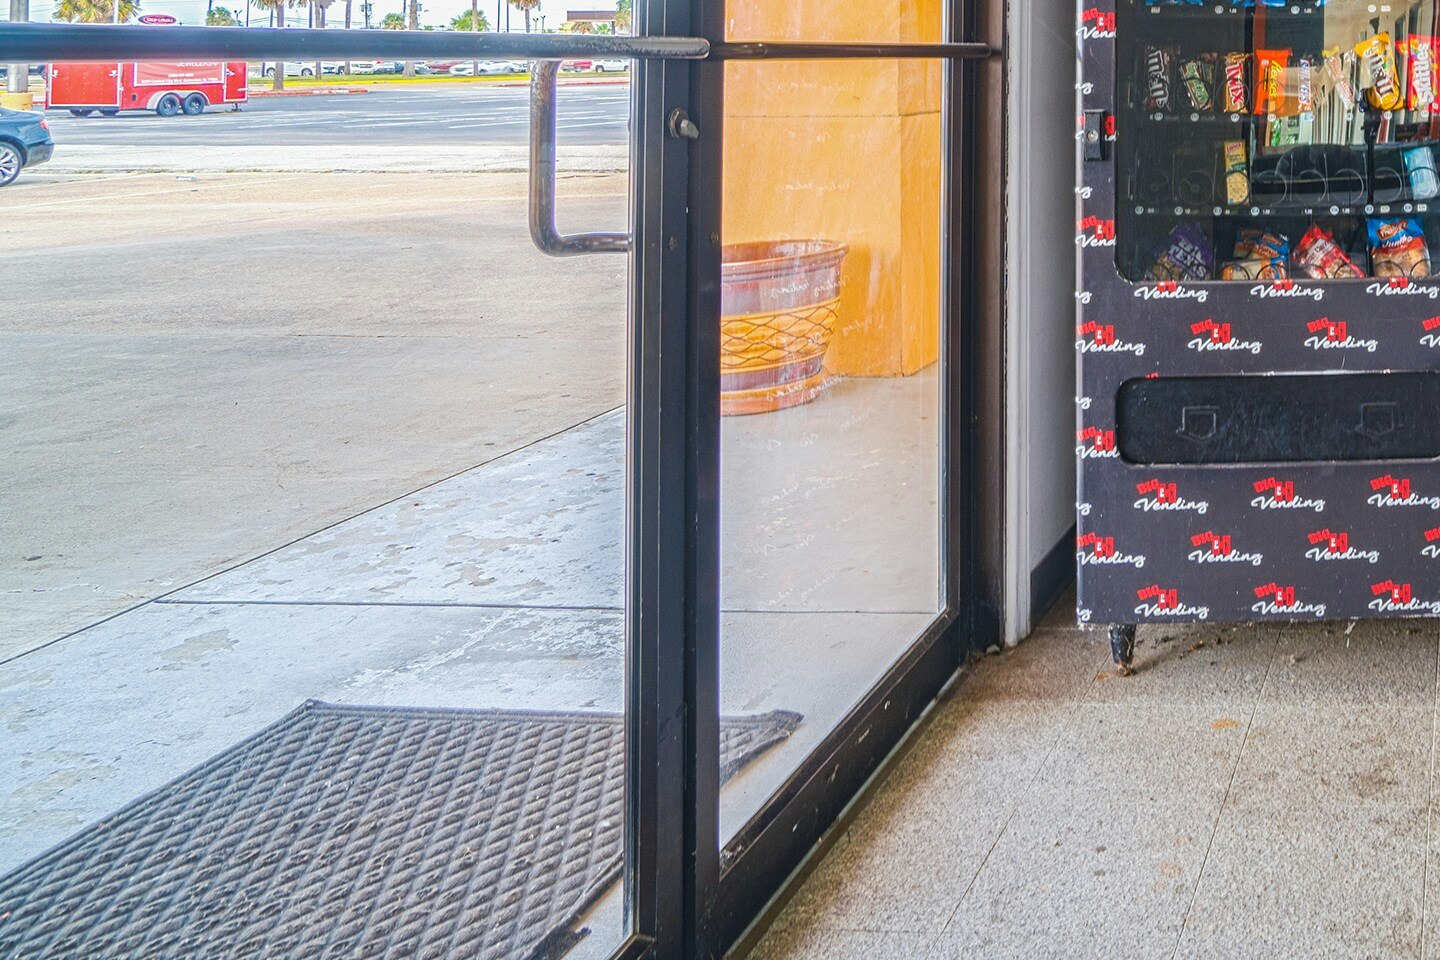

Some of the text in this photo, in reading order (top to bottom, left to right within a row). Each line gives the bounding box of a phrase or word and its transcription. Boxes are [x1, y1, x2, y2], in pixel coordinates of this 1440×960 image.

[1225, 62, 1244, 105] TWIX
[1412, 43, 1435, 106] Skittles
[1134, 285, 1208, 302] Vending
[1250, 284, 1325, 300] Vending
[1366, 282, 1440, 299] Vending
[1188, 337, 1263, 354] Vending
[1304, 335, 1379, 352] Vending
[1134, 496, 1208, 514] Vending
[1251, 494, 1325, 512] Vending
[1188, 548, 1263, 566] Vending
[1305, 546, 1379, 564] Vending
[1135, 602, 1210, 620] Vending
[1252, 599, 1327, 617] Vending
